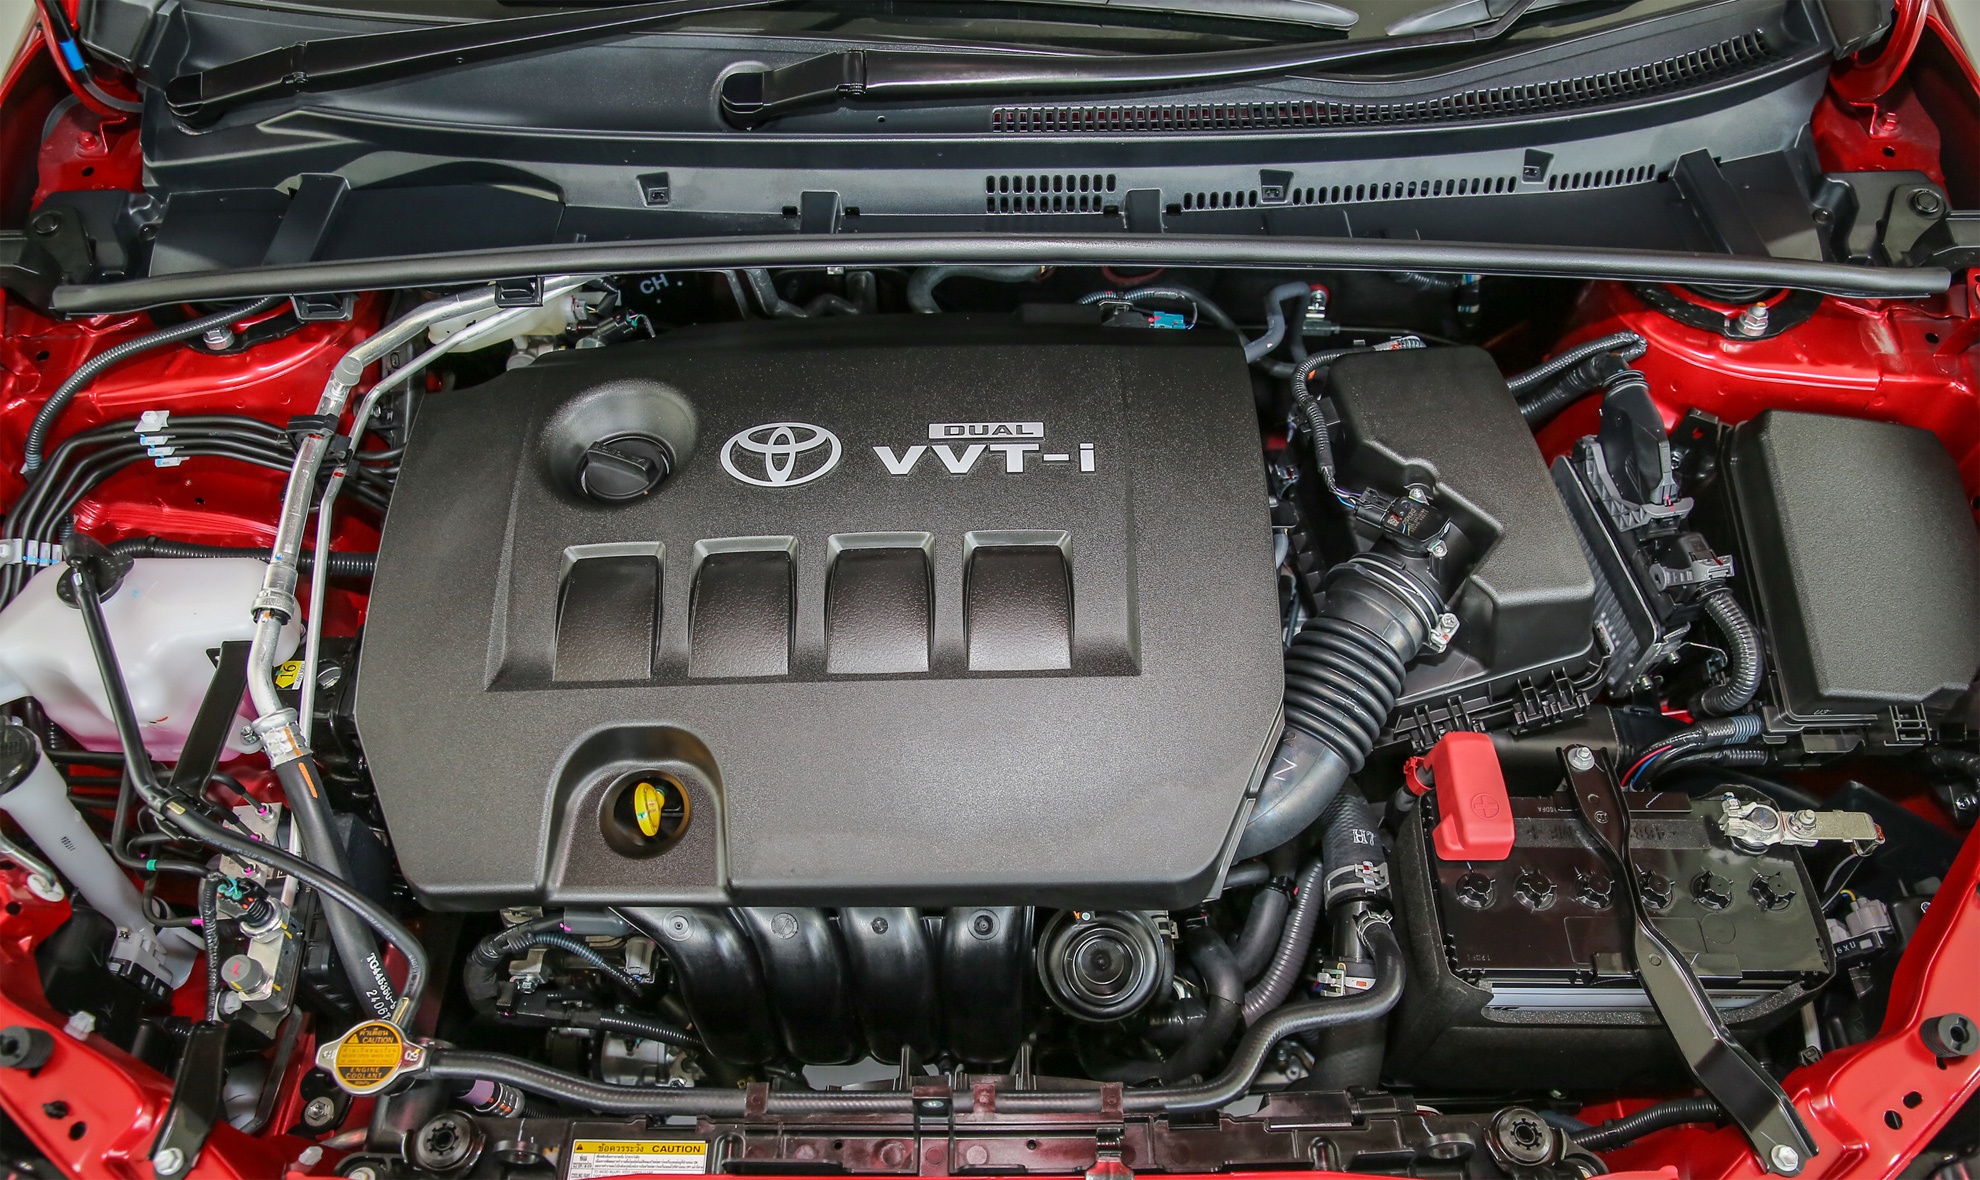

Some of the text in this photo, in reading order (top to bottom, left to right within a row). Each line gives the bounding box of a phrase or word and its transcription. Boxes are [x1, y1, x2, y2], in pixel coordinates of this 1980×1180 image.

[941, 424, 1036, 437] DUAL
[872, 442, 1096, 475] VVT-i
[280, 664, 297, 679] 16
[652, 1145, 701, 1153] CAUTION
